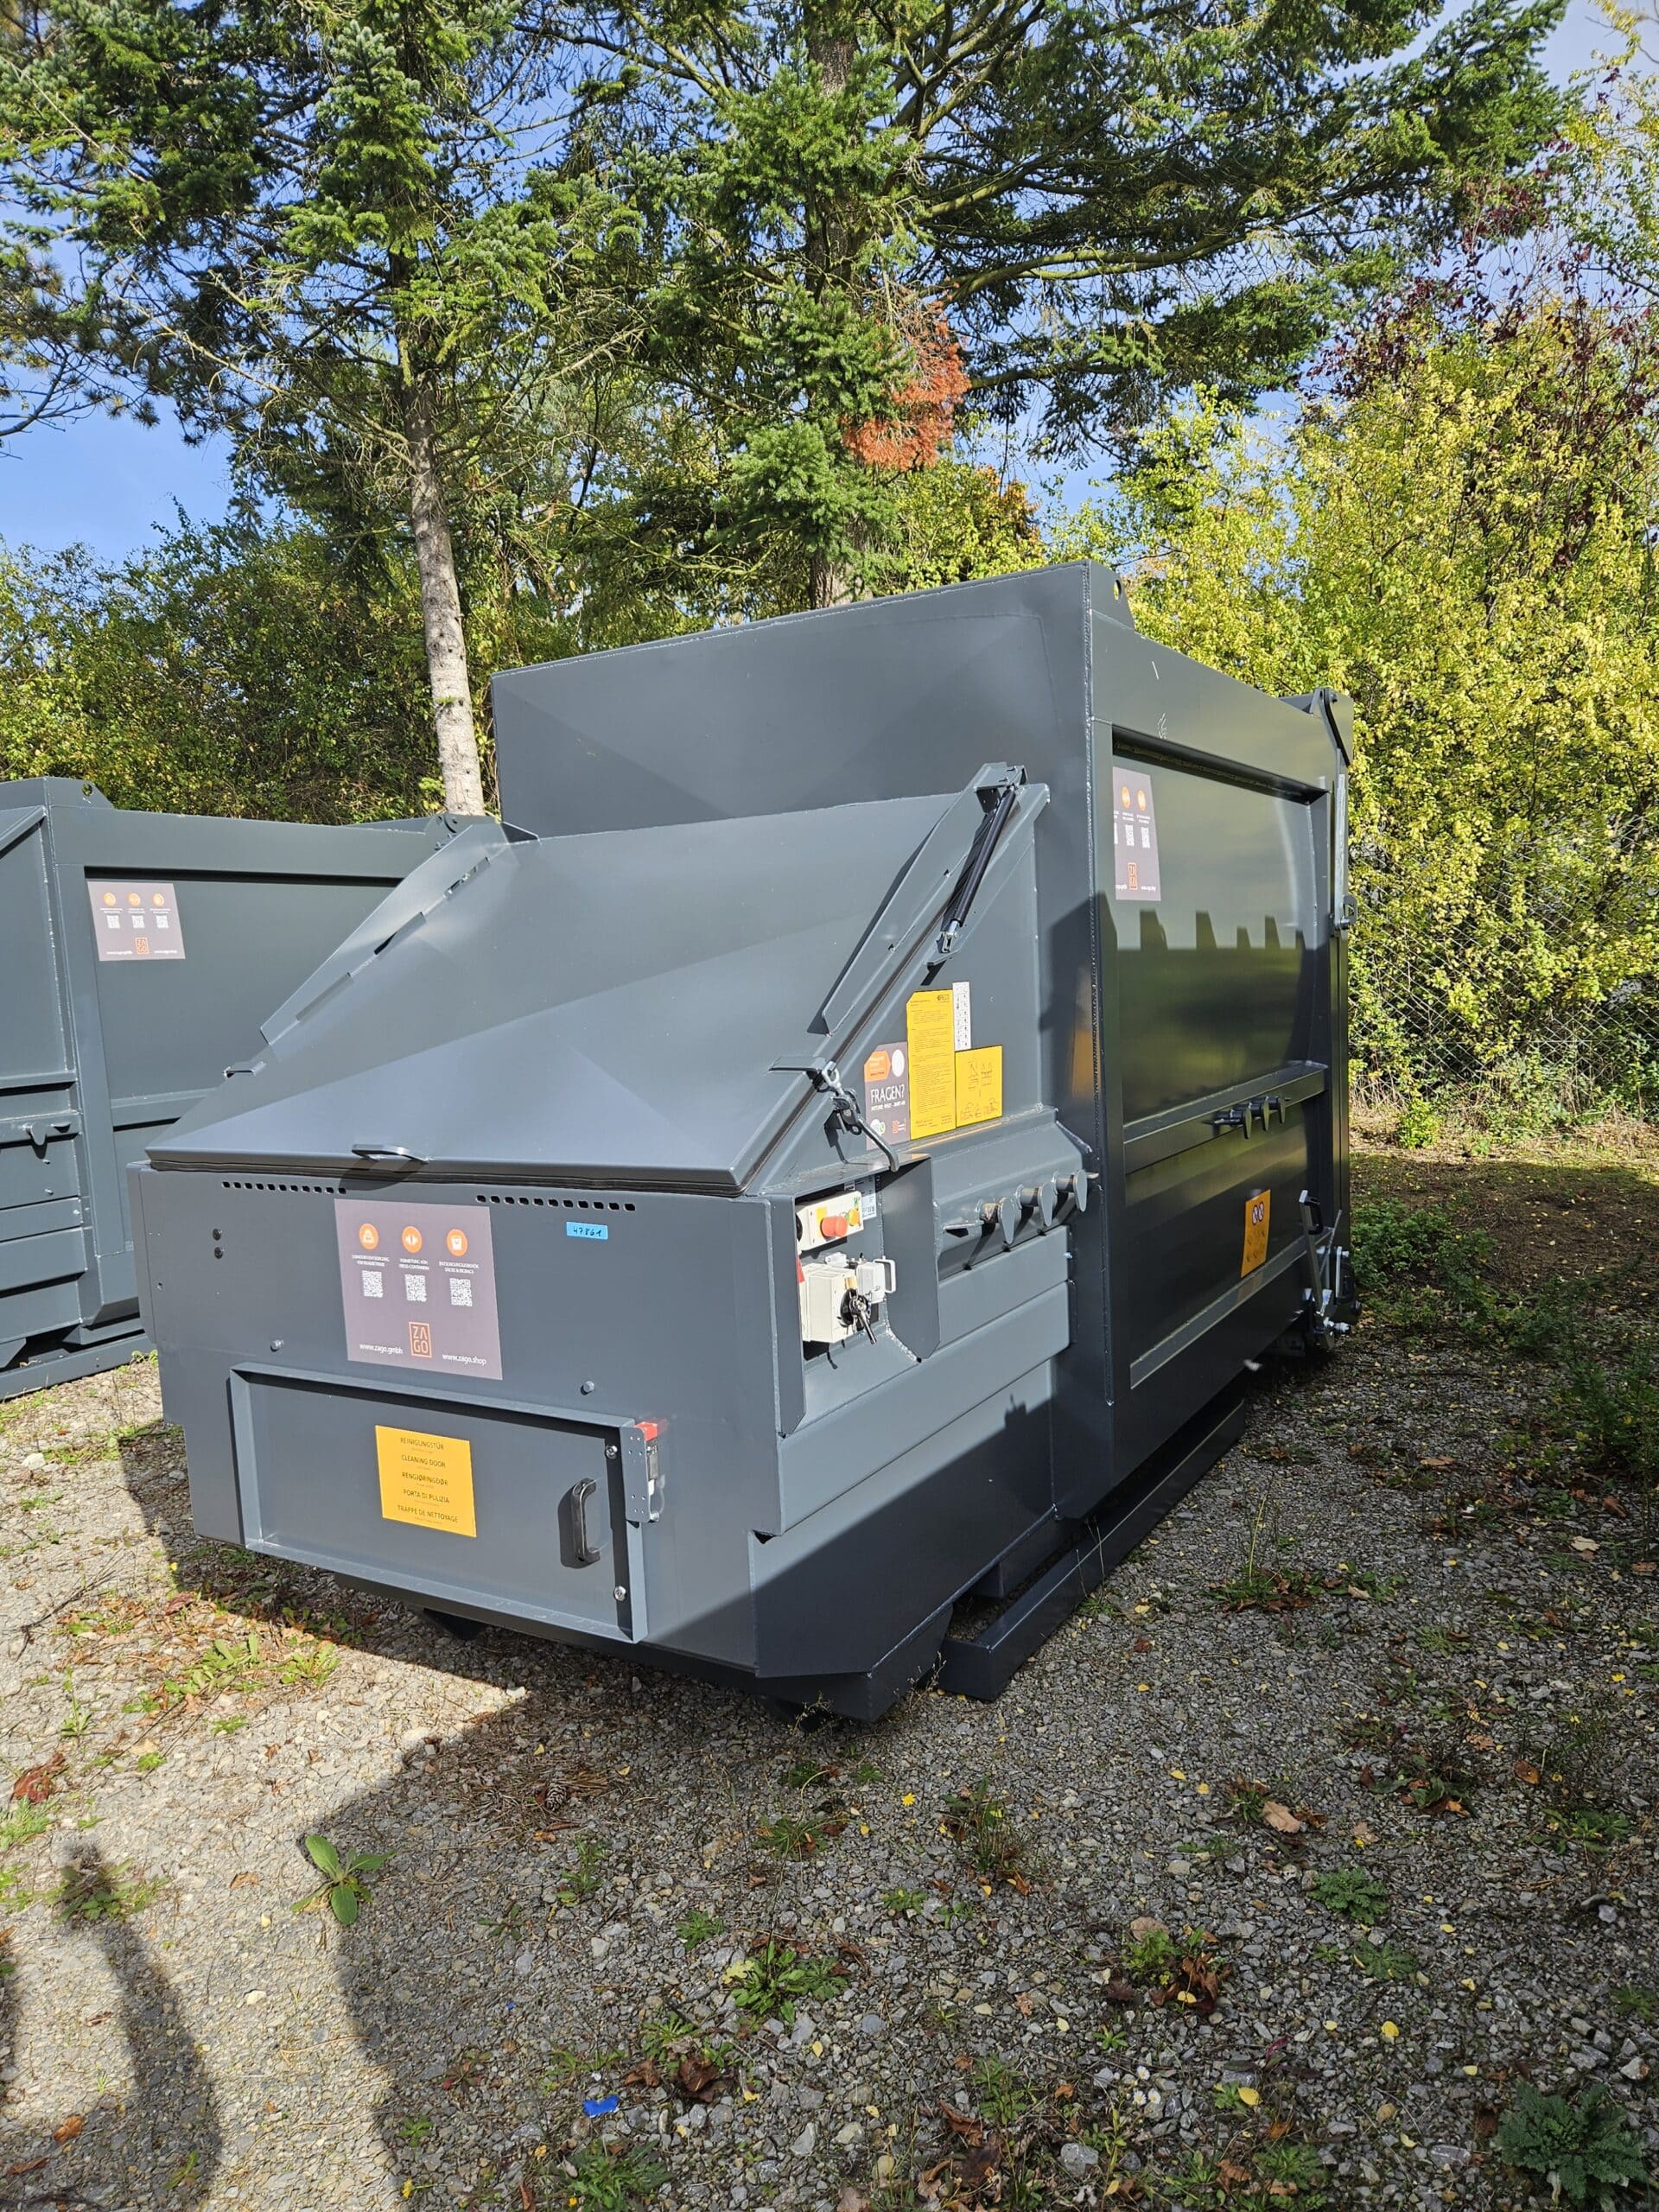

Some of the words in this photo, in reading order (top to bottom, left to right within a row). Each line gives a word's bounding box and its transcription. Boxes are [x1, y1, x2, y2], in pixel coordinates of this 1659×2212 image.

[870, 1084, 905, 1103] FRAGEN?
[359, 1343, 403, 1356] www.zago.gmbh
[442, 1353, 486, 1366] www.zago.shop
[400, 1437, 444, 1450] REINIGUNGSTÜR
[401, 1454, 428, 1465] CLEANING
[429, 1459, 446, 1468] DOOR
[404, 1489, 421, 1497] PORTA
[429, 1494, 449, 1503] PULIZIA
[397, 1504, 418, 1514] TRAPPE
[427, 1510, 459, 1522] NETTOYAGE
